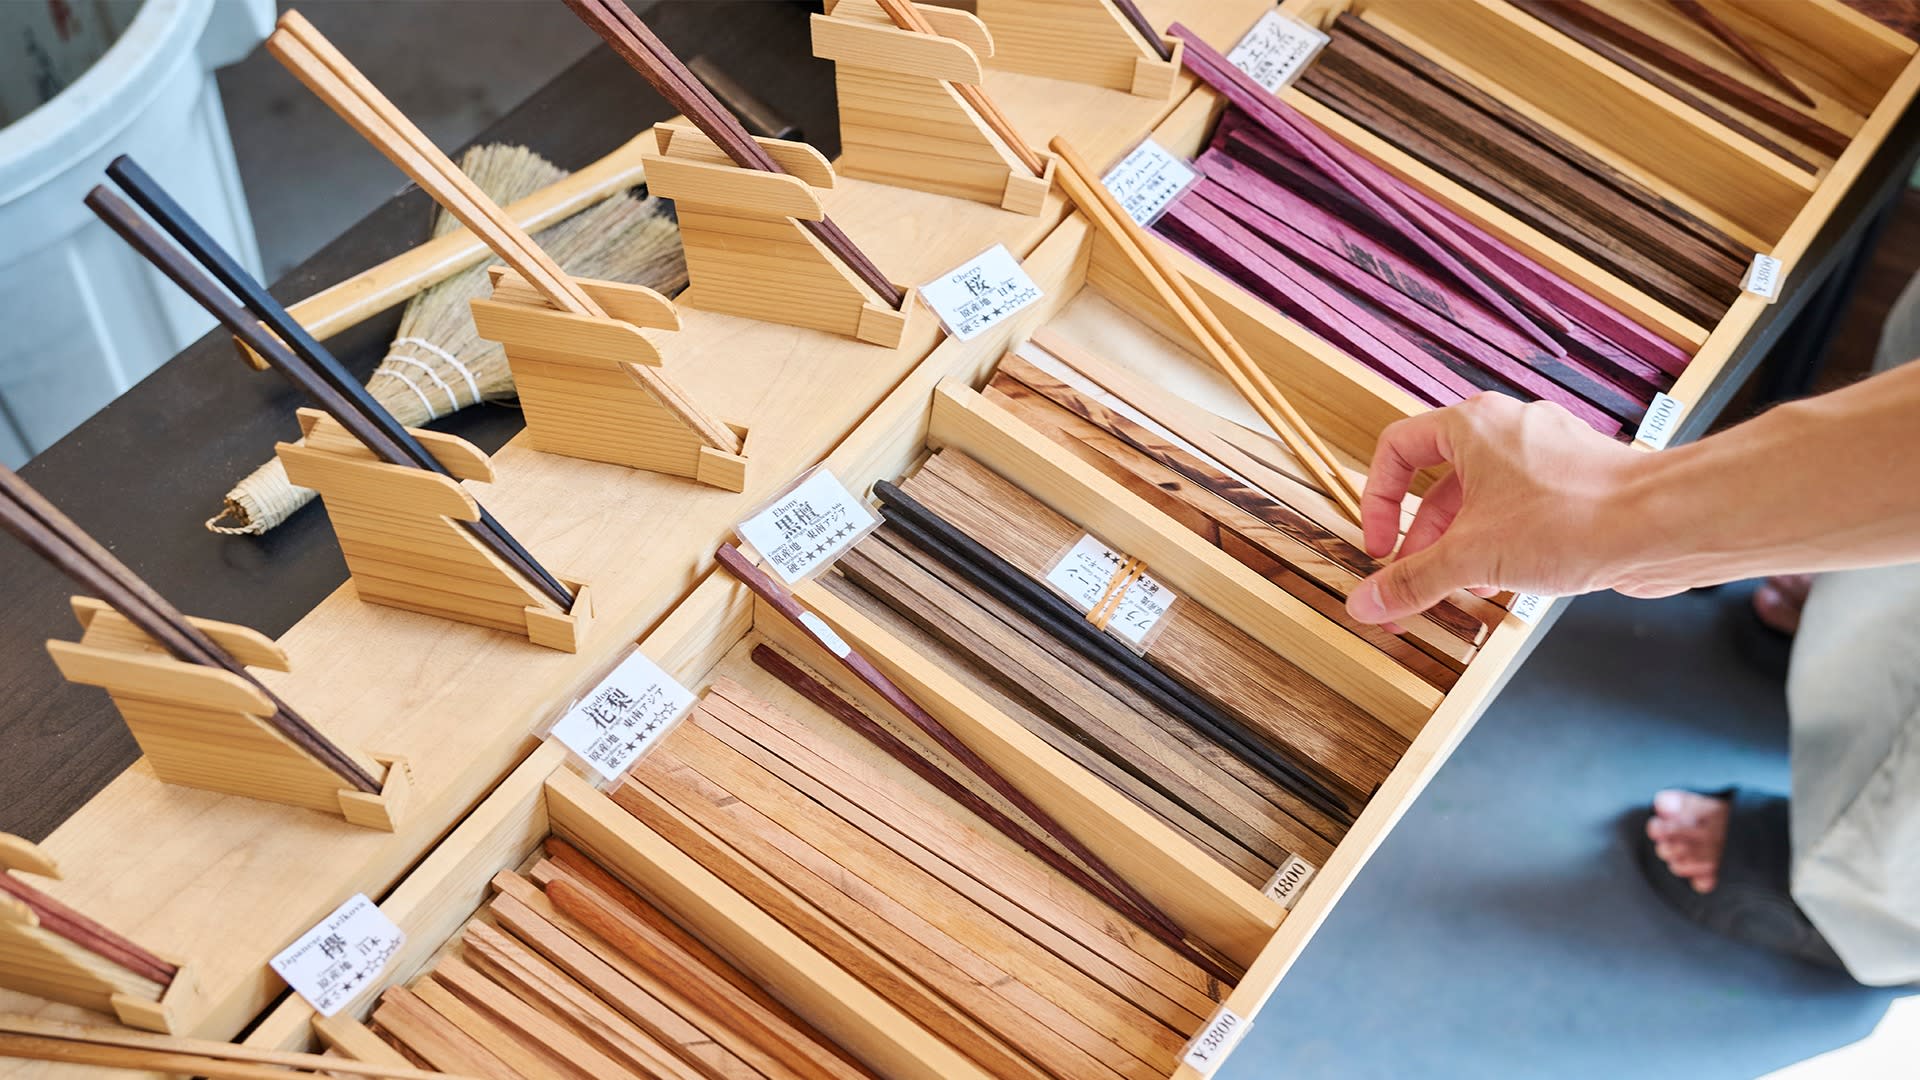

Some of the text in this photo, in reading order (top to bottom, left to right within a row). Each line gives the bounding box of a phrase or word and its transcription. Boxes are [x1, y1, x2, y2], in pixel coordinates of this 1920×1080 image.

[952, 266, 981, 283] Cherry
[965, 274, 991, 296] 桜
[771, 498, 799, 518] Ebony
[775, 501, 821, 541] 黒檀
[771, 506, 846, 564] 原産地 東南アジア
[787, 558, 807, 574] 硬さ
[585, 688, 633, 729] 花梨
[589, 687, 664, 762] 原産地 東南アジア
[607, 751, 627, 768] 硬さ
[1267, 863, 1306, 900] 4800
[279, 936, 321, 970] Japanese
